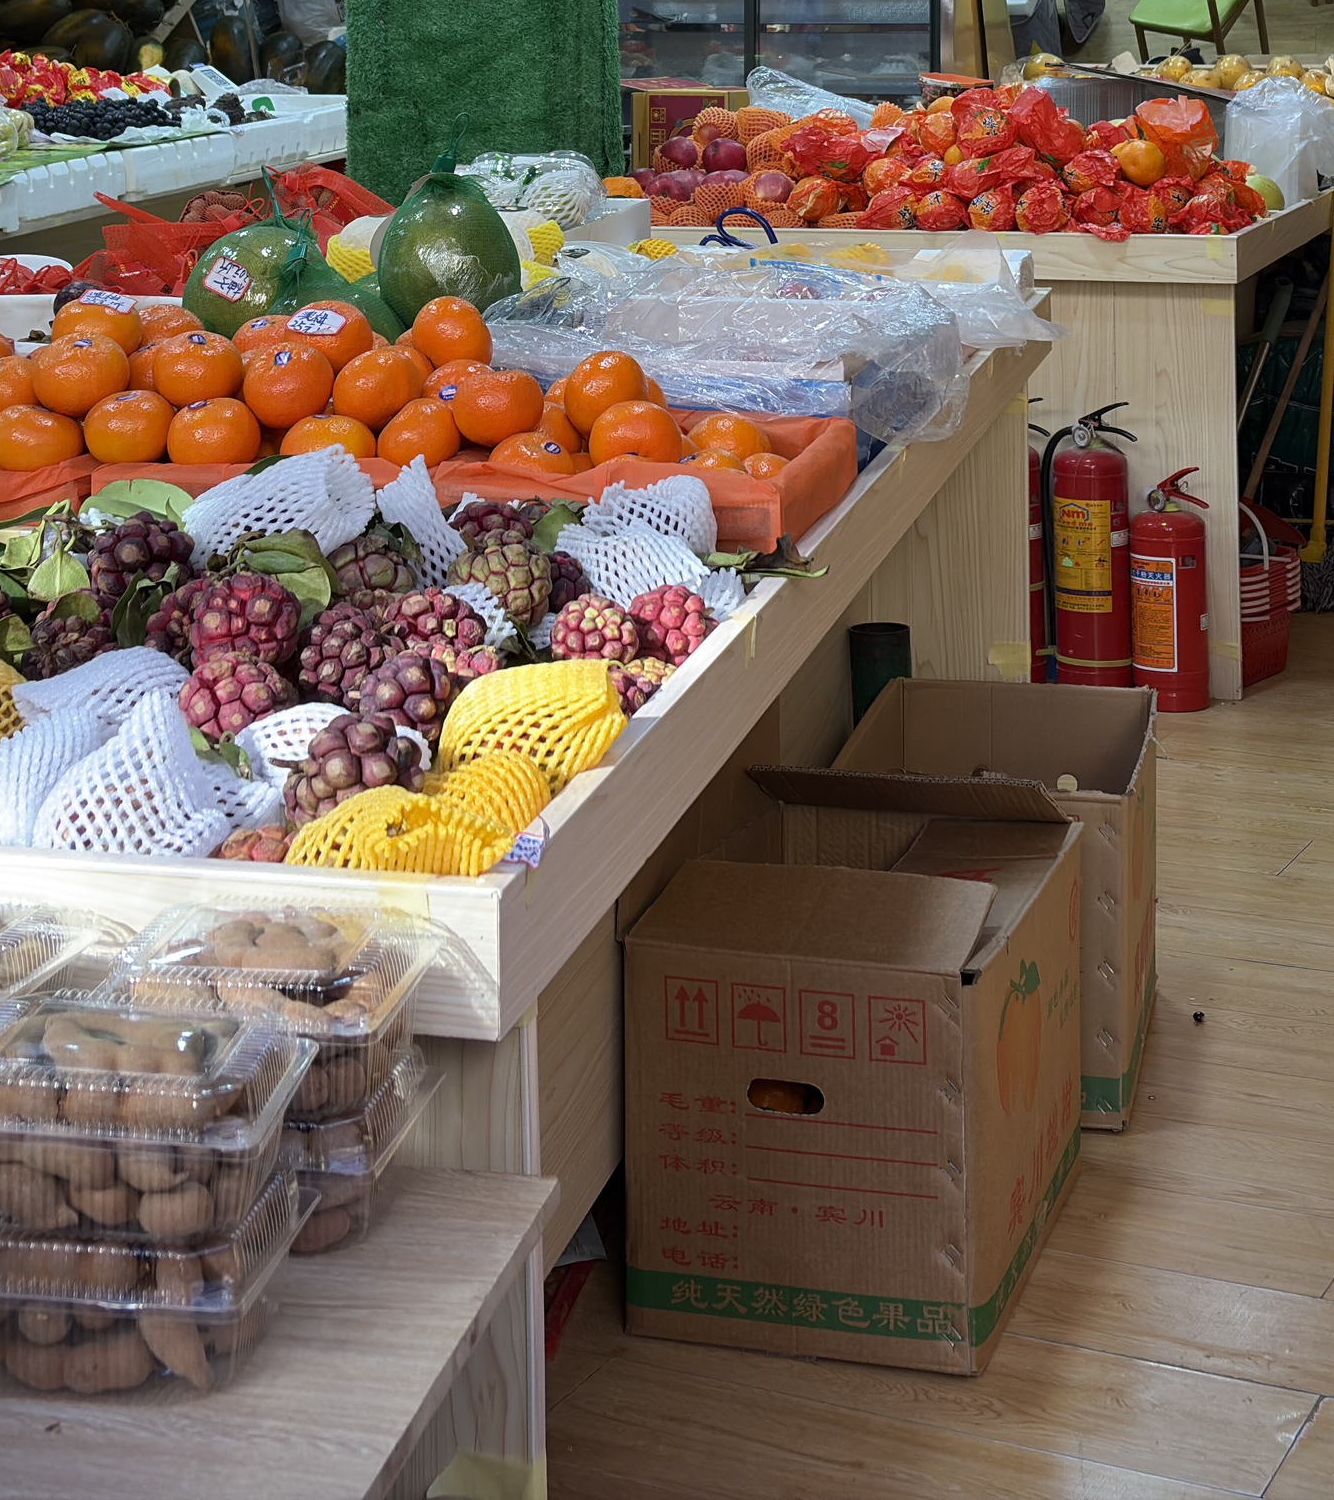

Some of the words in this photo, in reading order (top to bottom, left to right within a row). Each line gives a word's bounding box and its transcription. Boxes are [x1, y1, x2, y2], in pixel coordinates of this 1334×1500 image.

[816, 1000, 839, 1031] 8
[659, 1154, 739, 1177] 体积:
[659, 1216, 739, 1239] 地址:
[661, 1247, 739, 1270] 电话:
[671, 1278, 954, 1336] 纯天然绿色果品
